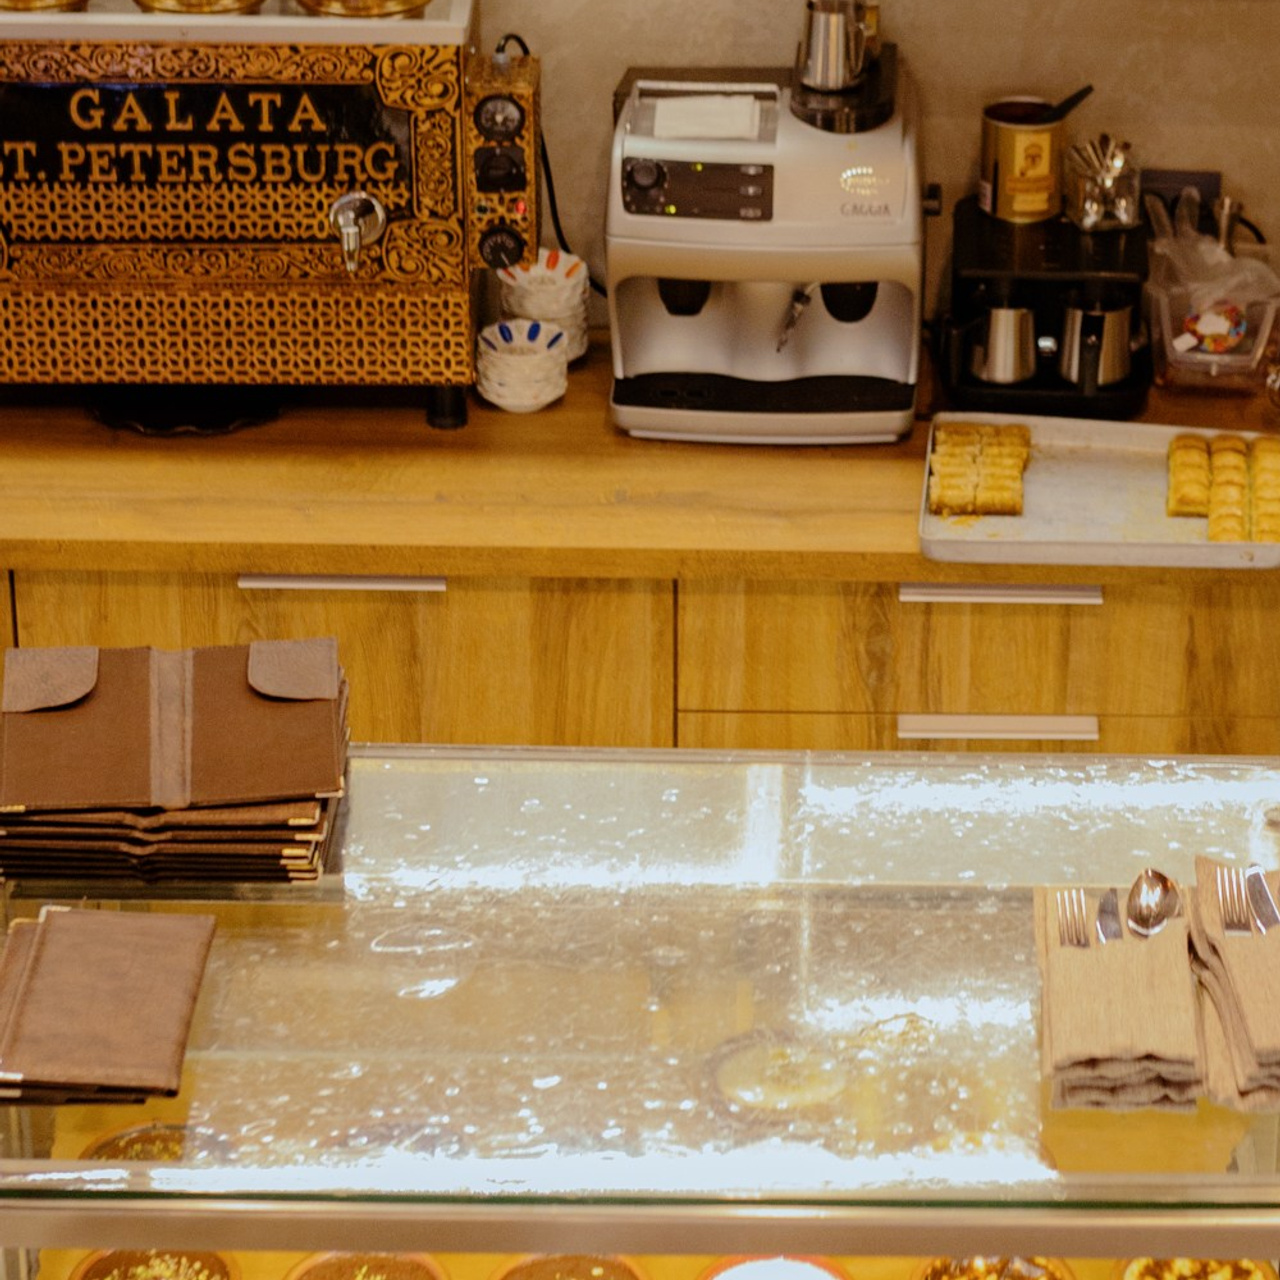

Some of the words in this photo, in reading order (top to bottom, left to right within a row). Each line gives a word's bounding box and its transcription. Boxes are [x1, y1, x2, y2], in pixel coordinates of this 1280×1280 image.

[69, 88, 327, 132] GALATA
[0, 140, 46, 182] T.
[57, 140, 400, 183] PETERSBURG
